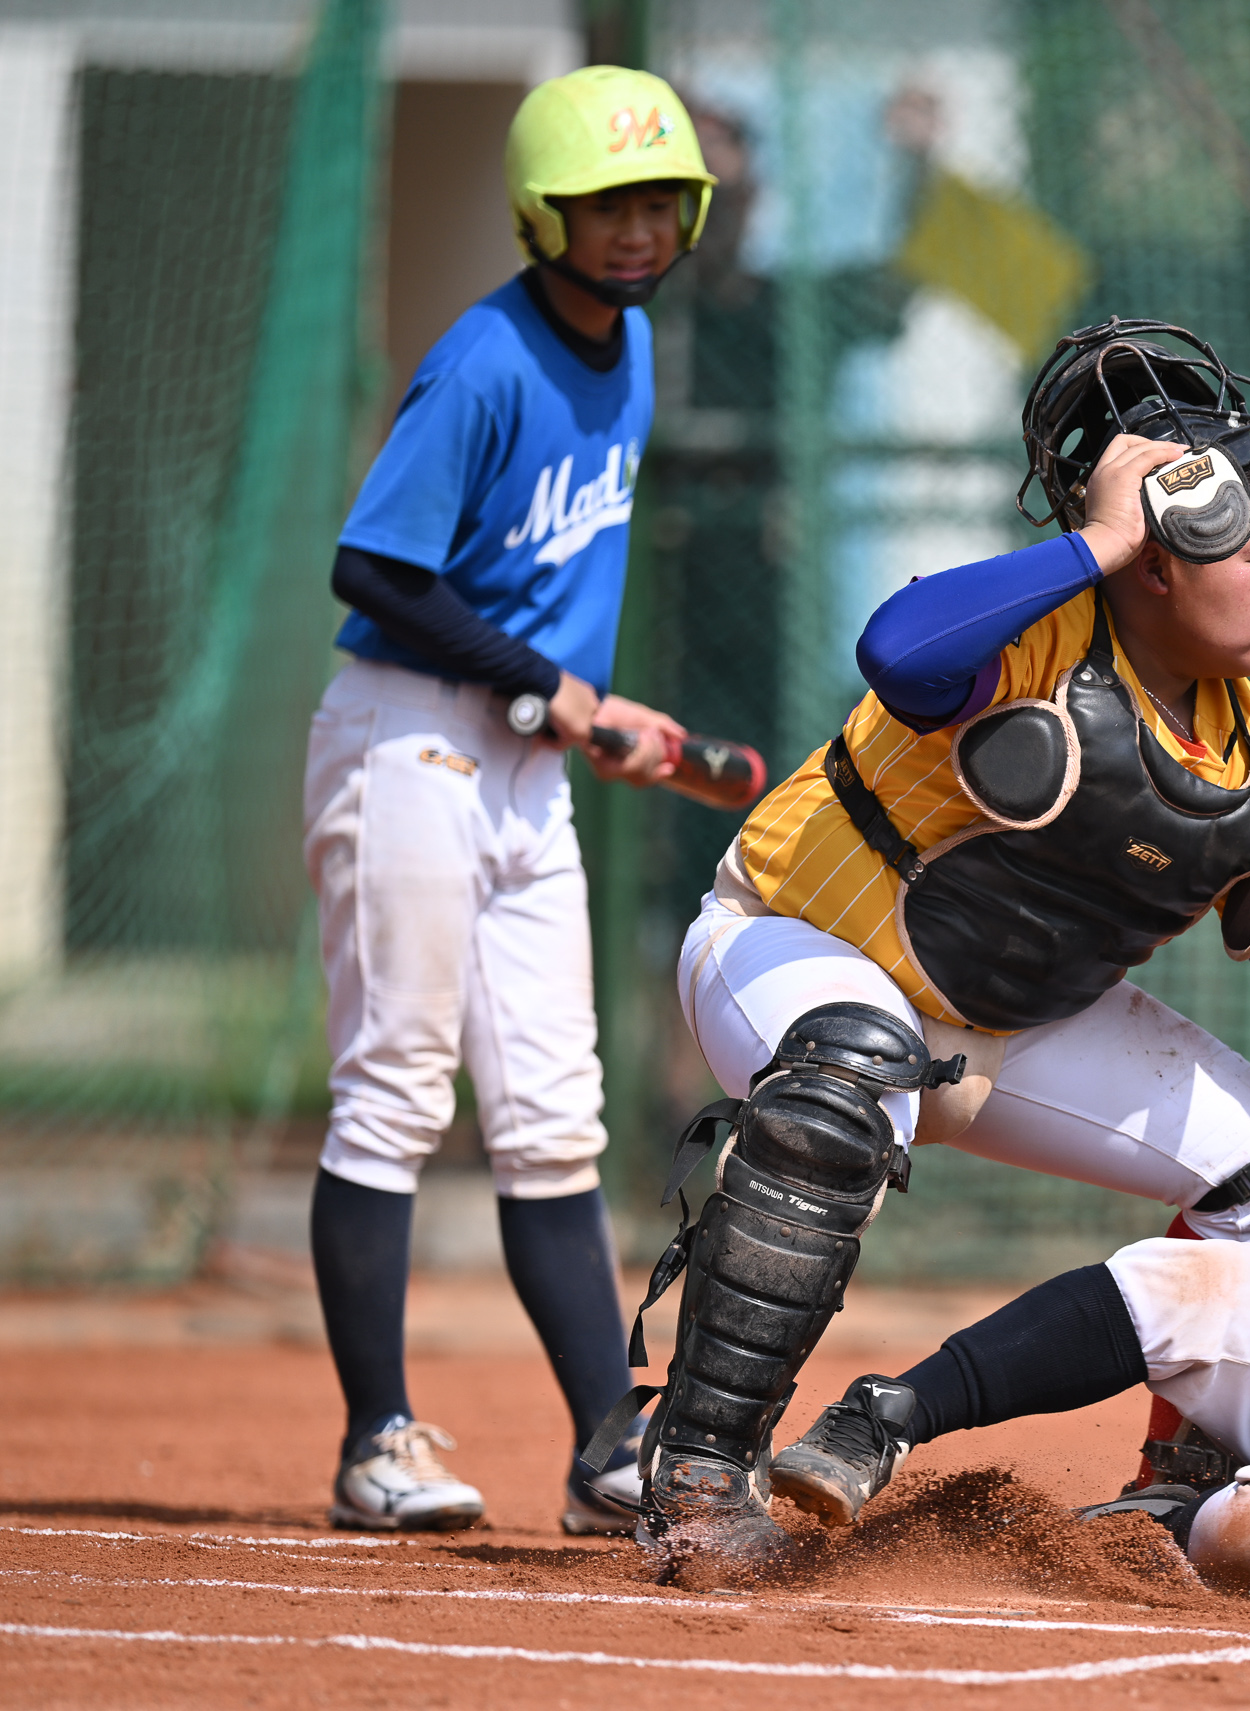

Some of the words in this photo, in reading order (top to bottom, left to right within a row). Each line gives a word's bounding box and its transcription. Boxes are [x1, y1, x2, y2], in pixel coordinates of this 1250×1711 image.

[1165, 459, 1207, 485] ZETT
[1126, 844, 1168, 868] ZETT
[749, 1180, 784, 1201] MITSUWA
[788, 1194, 828, 1214] Tiger
